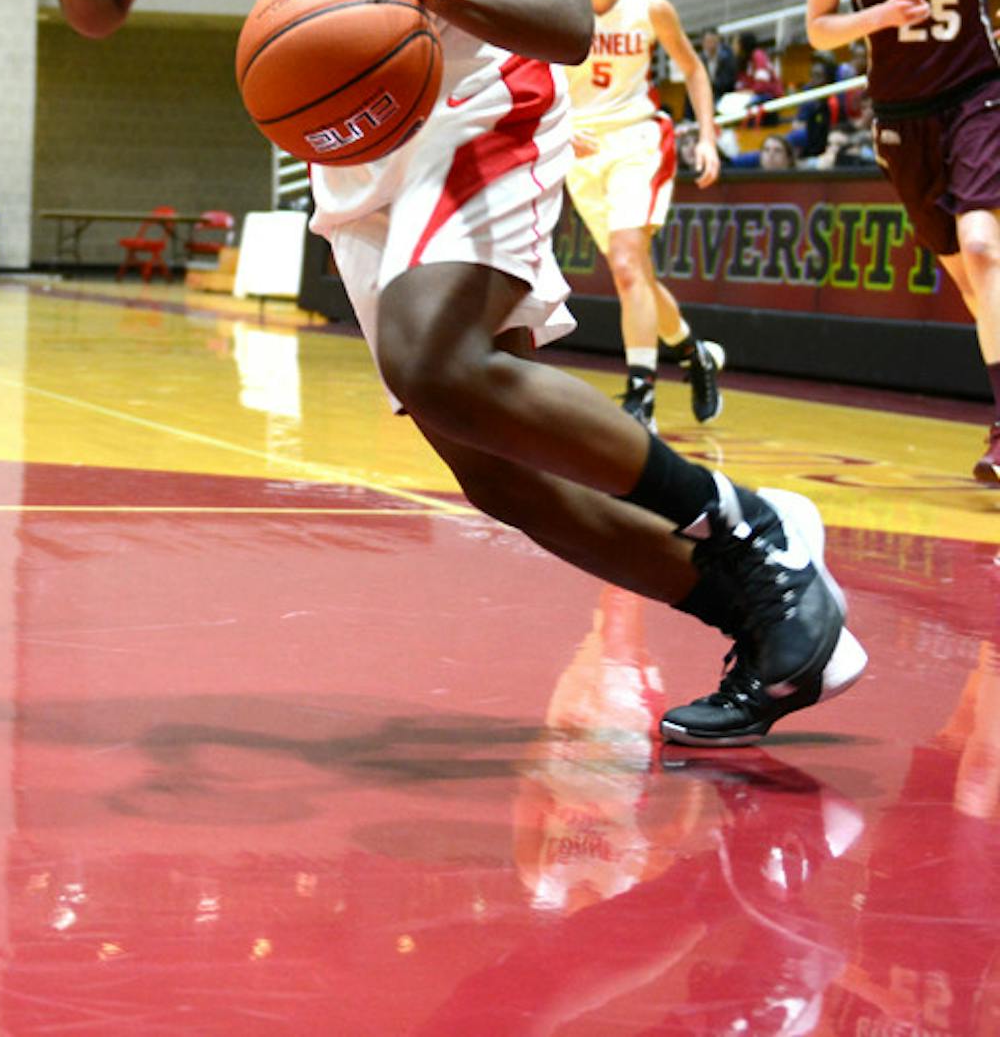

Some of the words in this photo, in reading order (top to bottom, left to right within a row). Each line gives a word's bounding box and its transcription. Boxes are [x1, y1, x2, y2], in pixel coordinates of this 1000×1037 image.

[591, 32, 643, 57] RNELL
[591, 61, 612, 90] 5
[304, 90, 400, 154] ELITE
[651, 202, 940, 293] NIVERSIT
